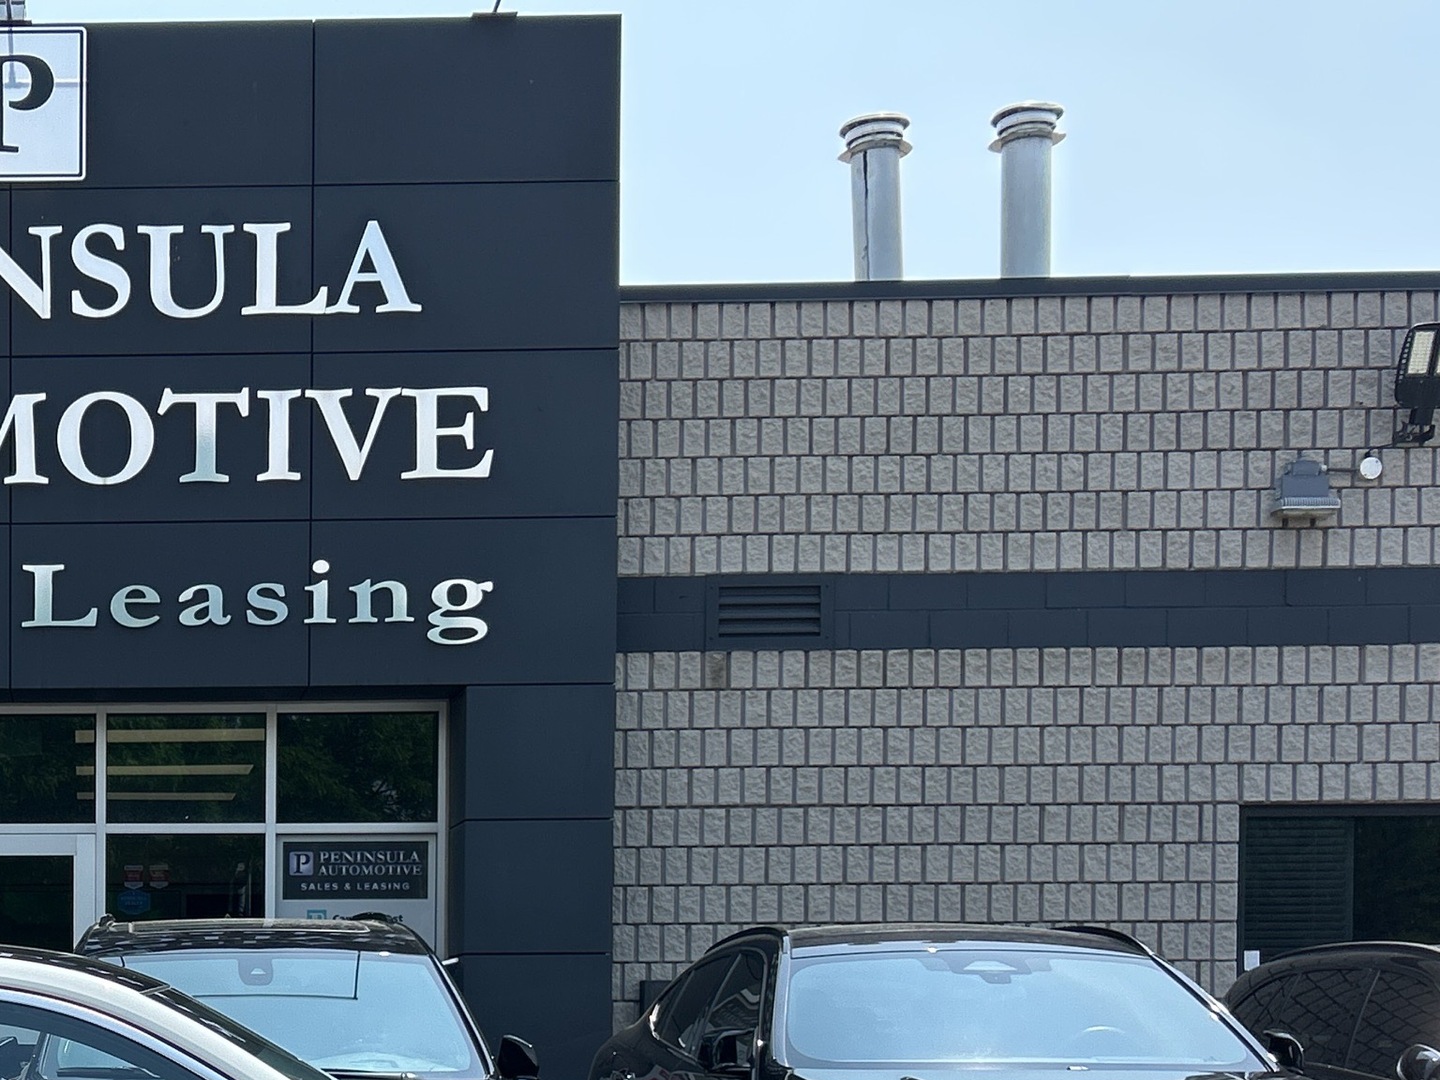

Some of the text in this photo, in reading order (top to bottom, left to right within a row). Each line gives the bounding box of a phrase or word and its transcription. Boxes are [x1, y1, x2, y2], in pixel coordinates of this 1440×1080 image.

[21, 559, 495, 646] Leasing
[319, 850, 421, 863] PENINSULA
[318, 864, 422, 876] AUTOMOTIVE
[300, 882, 410, 891] SALES & LEASING
